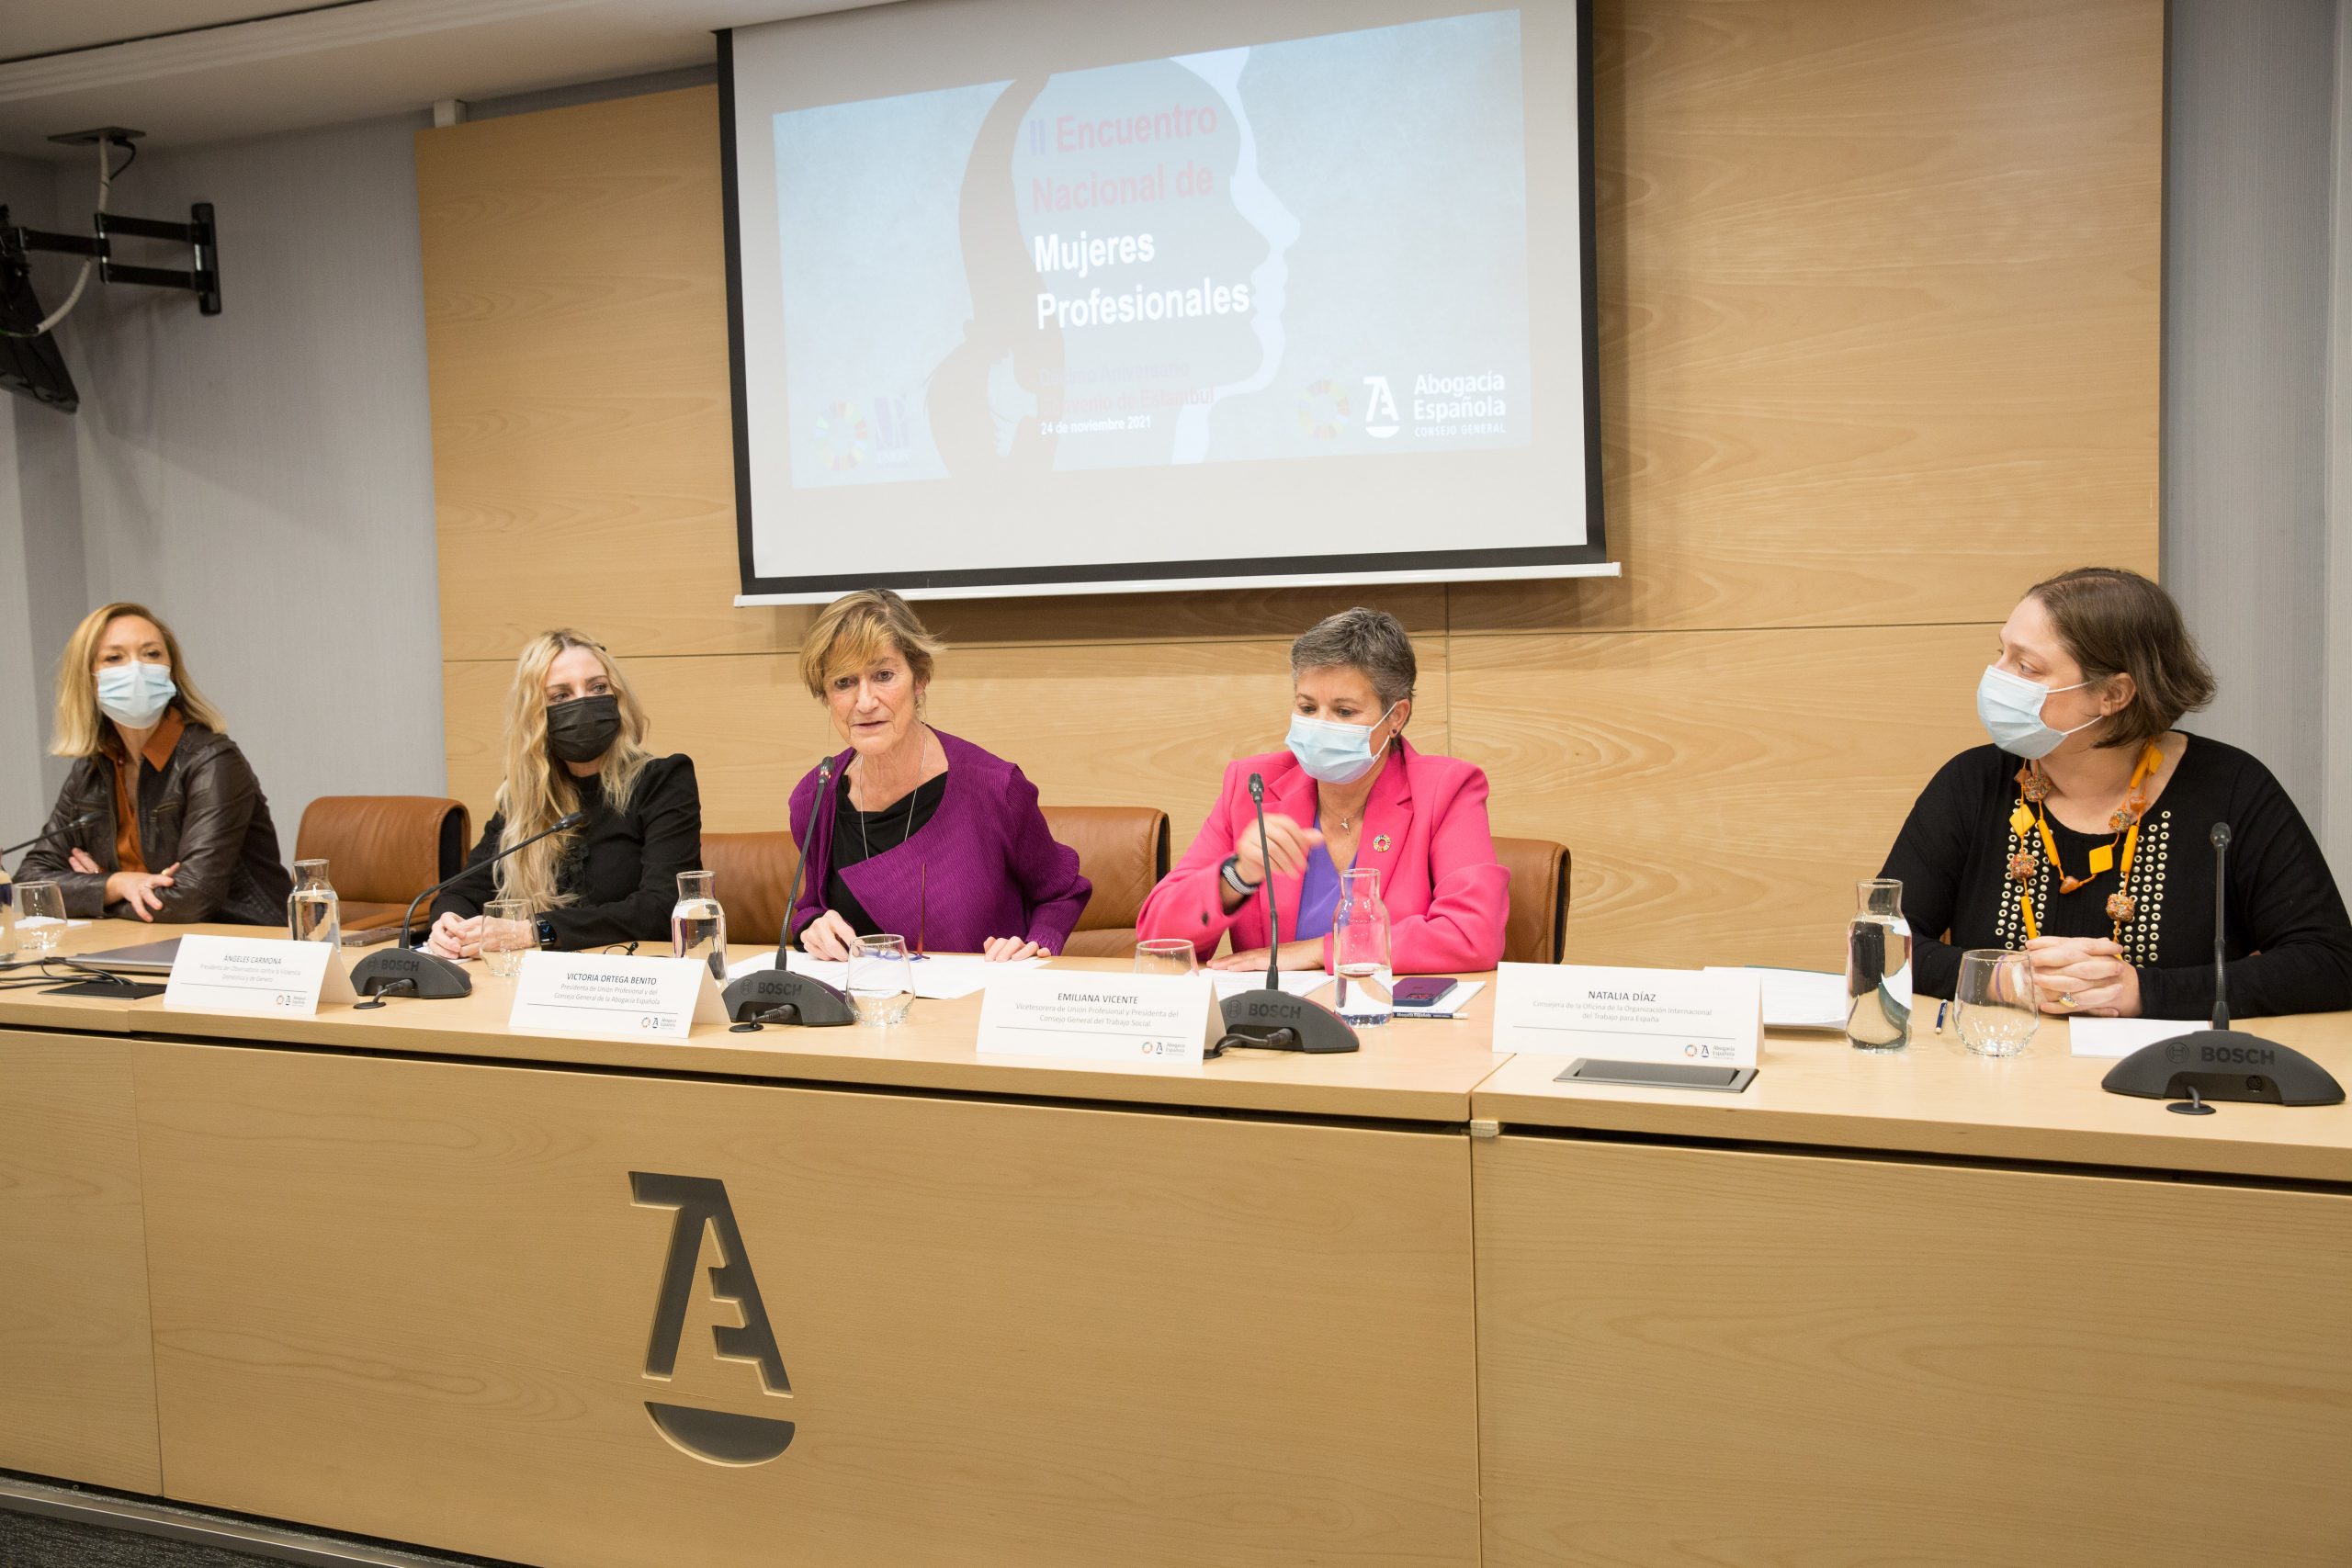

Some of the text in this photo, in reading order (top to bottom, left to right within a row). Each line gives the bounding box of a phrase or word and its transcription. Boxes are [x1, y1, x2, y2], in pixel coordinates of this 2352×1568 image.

[1029, 103, 1217, 156] II Encuentro
[1032, 159, 1215, 213] Nacional de
[1035, 231, 1156, 278] Mujeres
[1037, 276, 1250, 330] Profesionales
[1415, 370, 1506, 397] Abogacía
[1117, 390, 1136, 410] de
[1141, 384, 1215, 407] Estambul
[1415, 395, 1506, 423] Española
[1040, 414, 1151, 435] 24 de noviembre 2021
[1414, 423, 1507, 437] CONSEJO GENERAL
[250, 956, 282, 965] CARMONA
[381, 959, 419, 972] BOSCH
[560, 983, 589, 991] Presidenta
[567, 973, 657, 986] VICTORIA ORTEGA BENITO
[758, 982, 802, 996] BOSCH
[1588, 990, 1657, 1002] NATALIA DÍAZ
[554, 992, 575, 1000] Consejo
[576, 993, 596, 1001] General
[611, 996, 635, 1004] Abogacía
[636, 998, 661, 1006] Española
[1057, 992, 1138, 1005] EMILIANA VICENTE
[1015, 1002, 1057, 1012] Vicetesorera
[1057, 1004, 1067, 1012] de
[1067, 1005, 1087, 1013] Unión
[1088, 1006, 1125, 1015] Profesional
[1131, 1009, 1167, 1017] Presidenta
[1168, 1010, 1179, 1019] del
[1249, 1003, 1301, 1020] BOSCH
[1532, 1000, 1565, 1010] Consejera
[1575, 1001, 1581, 1010] la
[1582, 1002, 1606, 1010] Oficina
[1624, 1005, 1667, 1015] Organización
[1668, 1007, 1712, 1016] Internacional
[1039, 1014, 1066, 1023] Consejo
[1067, 1016, 1093, 1024] General
[1106, 1018, 1130, 1027] Trabajo
[1131, 1019, 1151, 1027] Social
[1594, 1012, 1618, 1021] Trabajo
[1635, 1015, 1659, 1023] España
[2200, 1046, 2274, 1065] BOSCH
